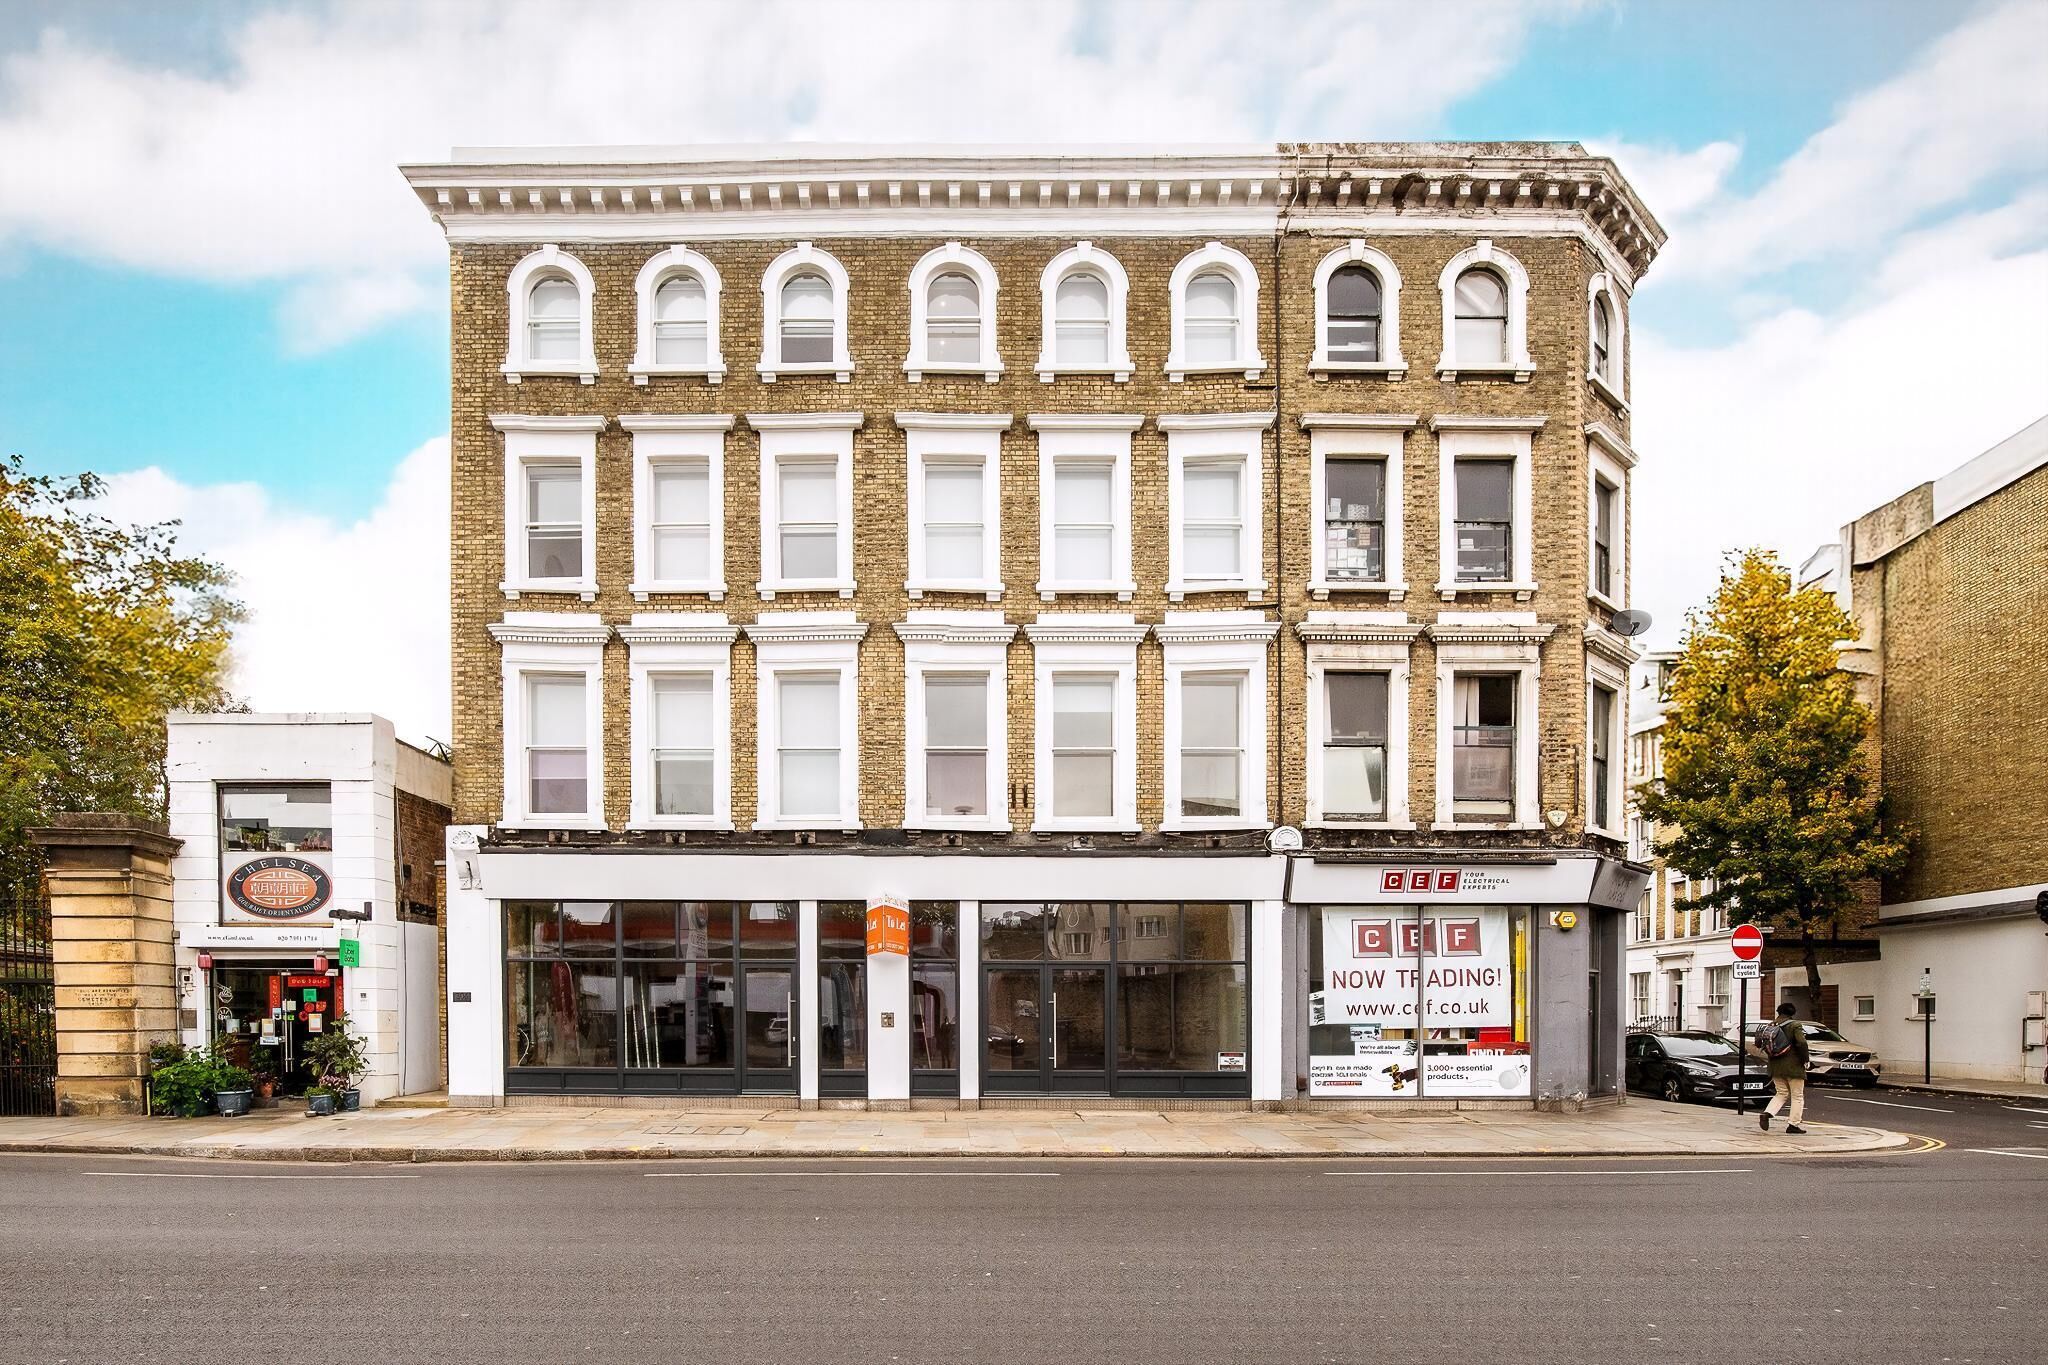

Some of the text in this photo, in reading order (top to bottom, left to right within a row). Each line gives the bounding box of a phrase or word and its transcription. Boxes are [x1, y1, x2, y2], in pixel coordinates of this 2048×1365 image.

[234, 858, 322, 882] CHELSEA
[1388, 875, 1452, 887] CEF
[1364, 928, 1467, 948] CEF
[1332, 969, 1385, 989] NOW
[1456, 1064, 1493, 1072] essential
